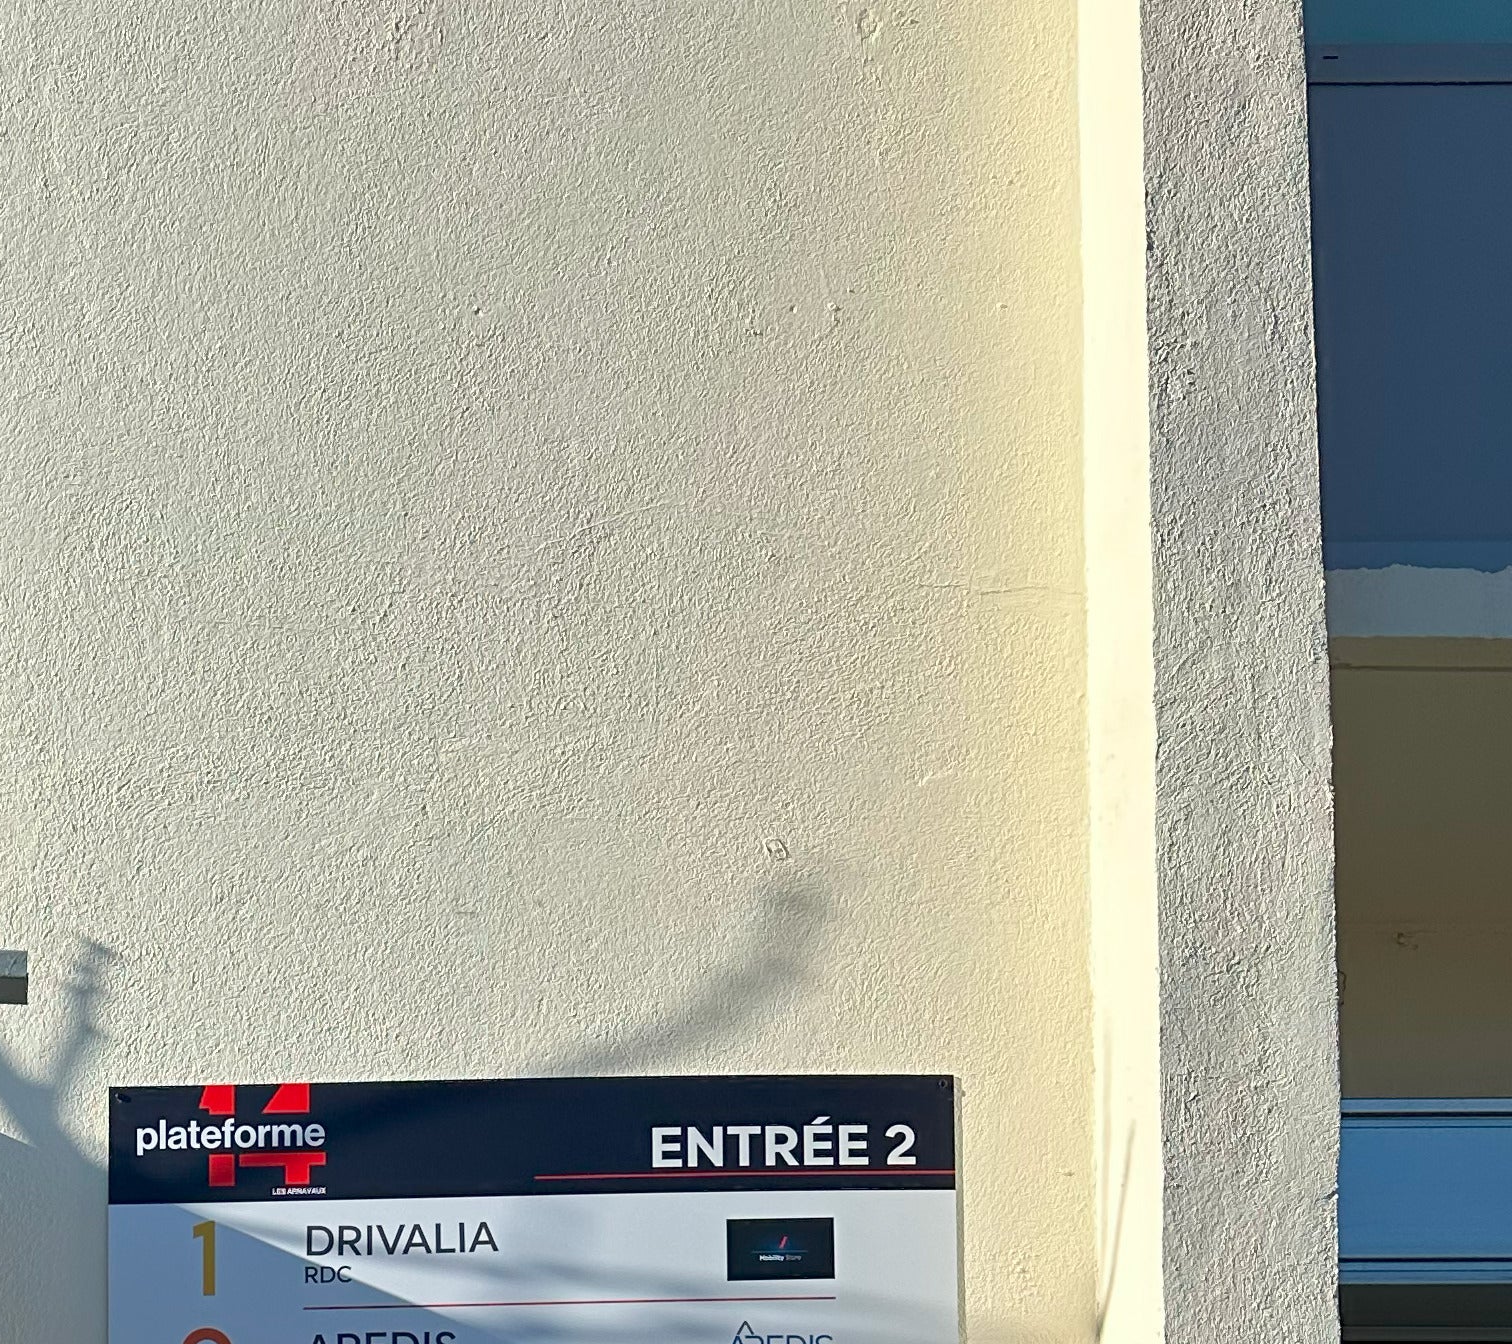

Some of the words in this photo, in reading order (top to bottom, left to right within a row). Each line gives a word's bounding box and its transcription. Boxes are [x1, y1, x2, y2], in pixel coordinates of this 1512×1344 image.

[136, 1117, 326, 1156] plateforme
[651, 1116, 869, 1168] ENTRÉE
[884, 1122, 918, 1167] 2
[192, 1216, 216, 1297] 1
[306, 1221, 499, 1257] DRIVALIA
[304, 1262, 352, 1284] RDC
